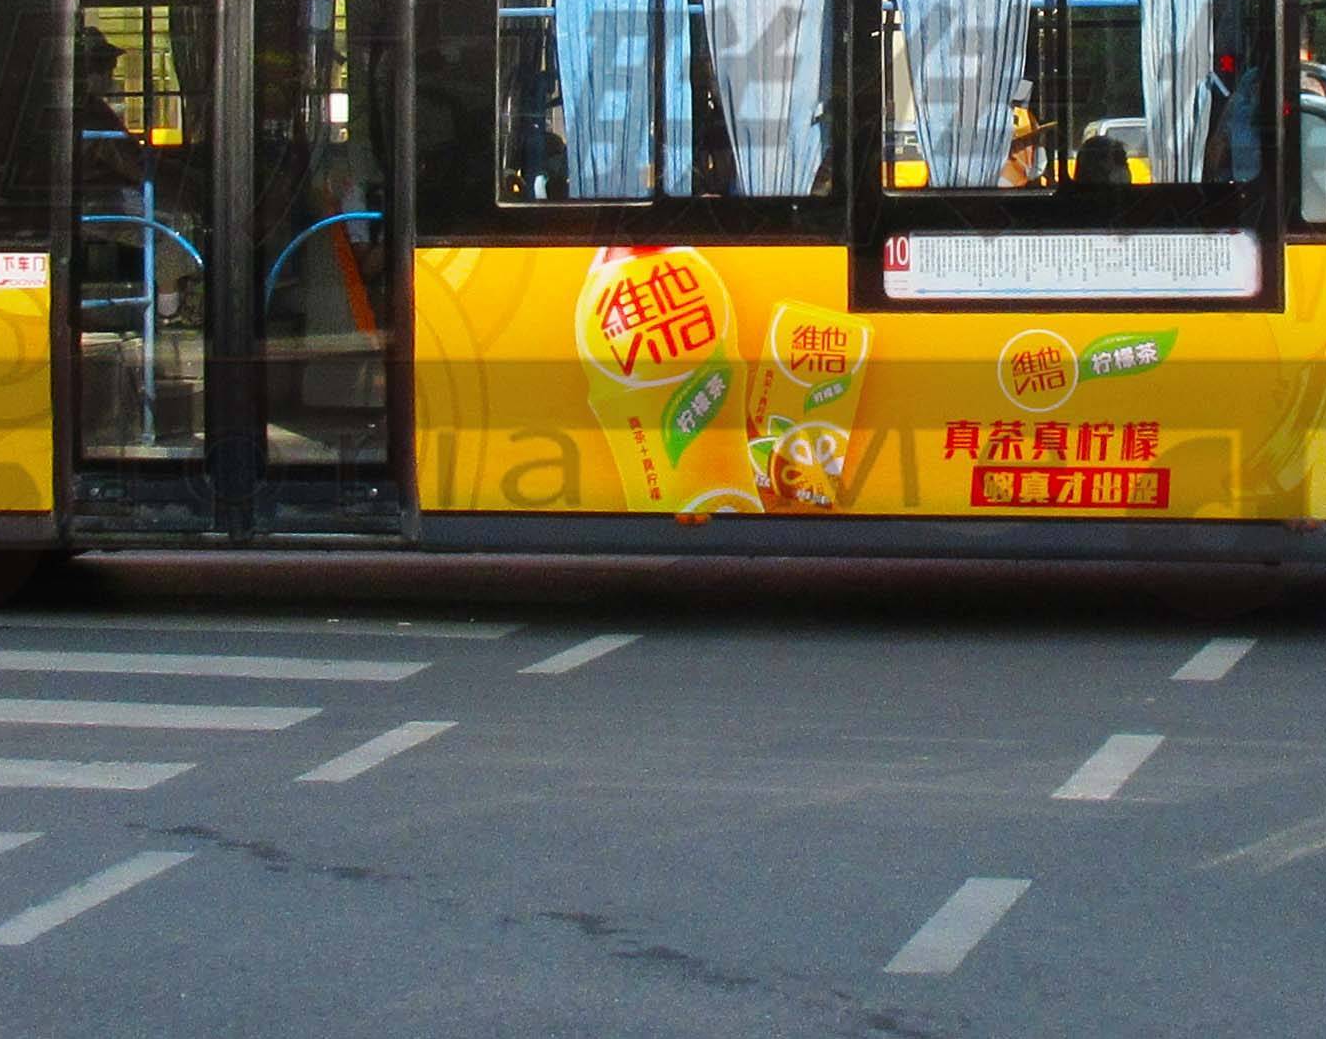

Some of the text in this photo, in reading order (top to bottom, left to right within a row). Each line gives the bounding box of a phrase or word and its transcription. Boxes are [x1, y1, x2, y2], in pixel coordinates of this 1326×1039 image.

[3, 255, 46, 271] 下车门
[886, 236, 909, 266] 10
[595, 261, 704, 340] 維他
[790, 322, 848, 353] 維他
[1010, 345, 1062, 377] 維他
[1090, 341, 1160, 375] 柠檬茶
[675, 371, 727, 434] 柠檬茶
[943, 419, 1161, 463] 真茶真柠檬
